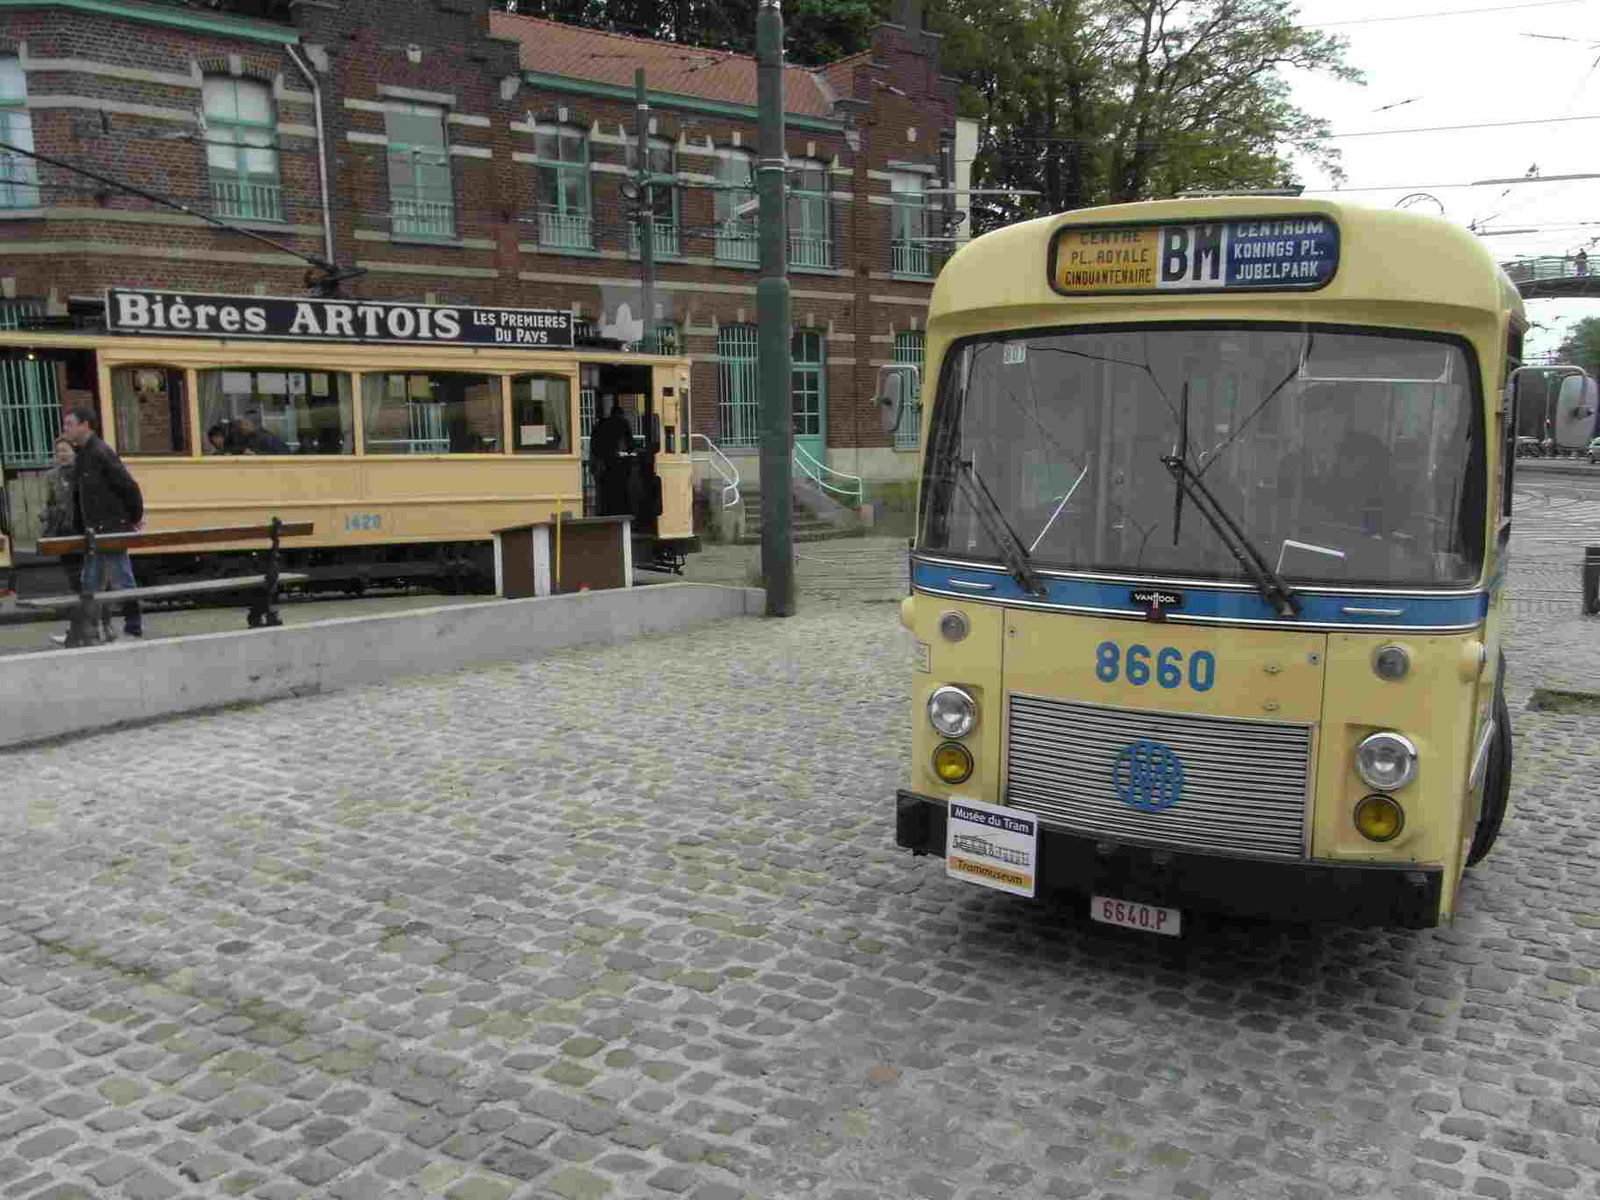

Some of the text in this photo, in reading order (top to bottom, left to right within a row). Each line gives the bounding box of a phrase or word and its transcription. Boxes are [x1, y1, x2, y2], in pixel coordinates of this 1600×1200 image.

[1080, 231, 1142, 245] CENTRE
[1236, 222, 1324, 237] CENTRUM
[1071, 249, 1149, 264] PL. ROYALE
[1163, 226, 1221, 282] BM
[1234, 241, 1324, 259] KONINGS PL.
[1065, 268, 1151, 286] CINQUANTENAIRE
[1236, 262, 1319, 280] JUBELPARK
[118, 293, 461, 338] Bières ARTOIS
[473, 311, 567, 329] LES PREMIERES
[495, 328, 549, 344] DU PAYS
[1096, 641, 1215, 692] 8660
[955, 807, 1029, 834] Musée du Tram
[957, 859, 1023, 885] Trammuseum
